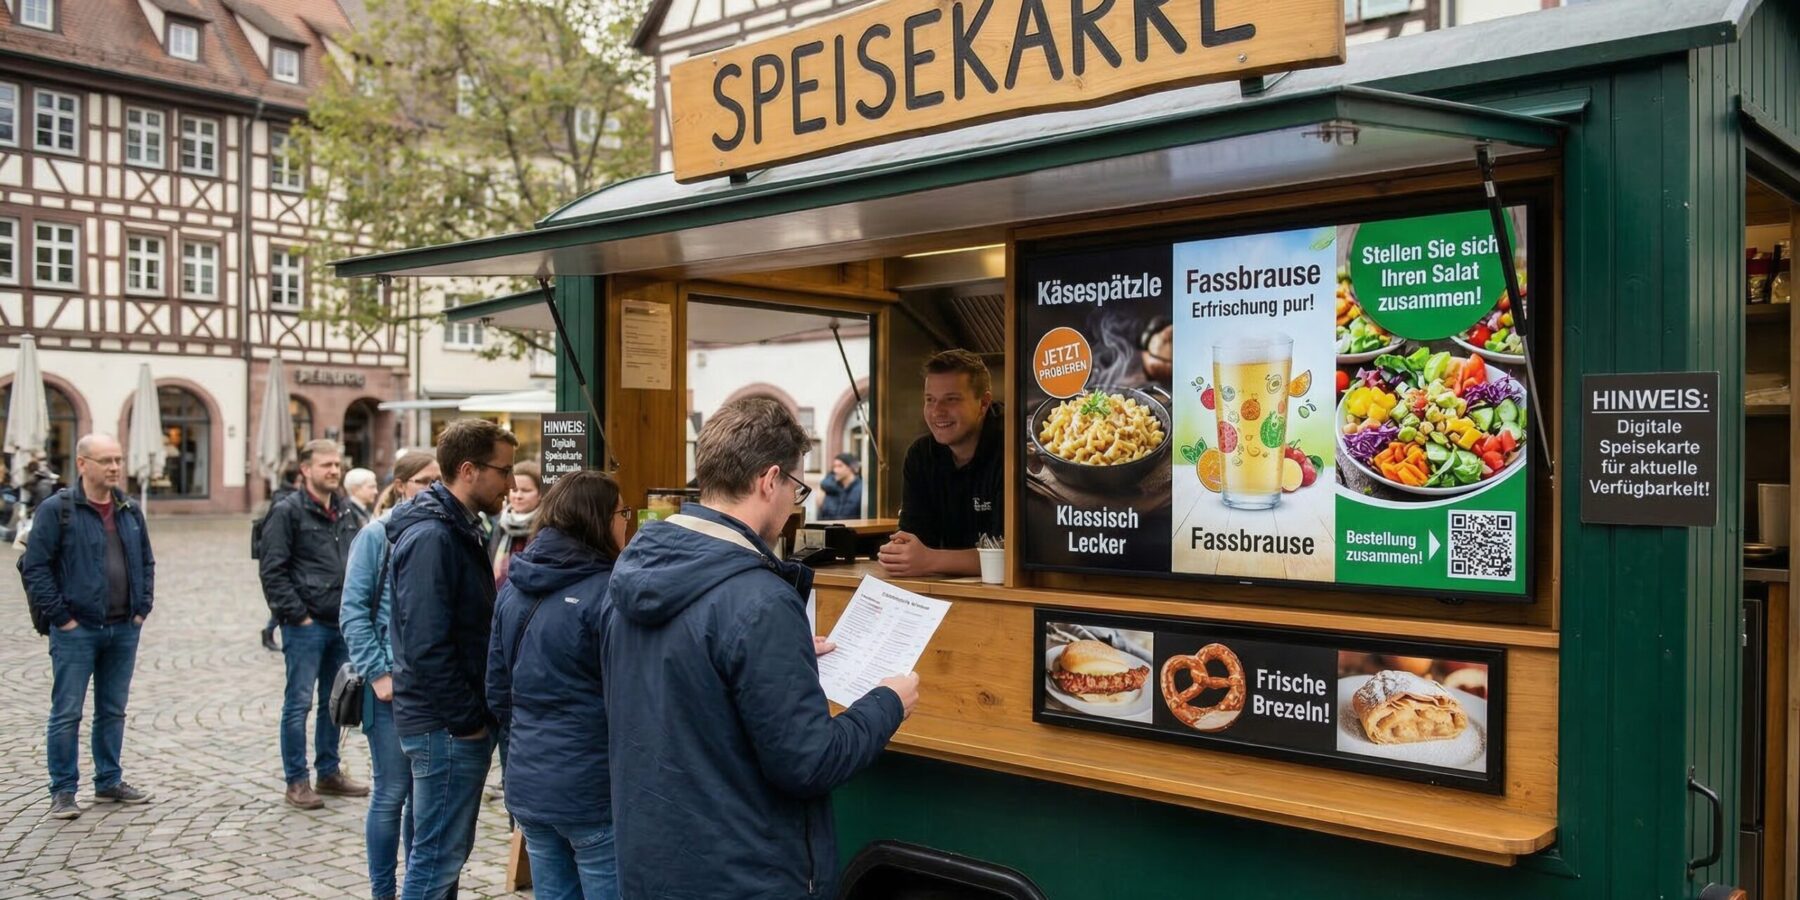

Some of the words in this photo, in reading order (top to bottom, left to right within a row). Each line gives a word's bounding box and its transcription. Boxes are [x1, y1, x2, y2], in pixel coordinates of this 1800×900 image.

[1362, 242, 1422, 265] Stellen
[1427, 238, 1456, 259] Sie
[1461, 234, 1499, 256] sich
[1186, 264, 1321, 294] Fassbrause
[1381, 266, 1427, 287] Ihren
[1432, 262, 1480, 284] Salat
[1037, 272, 1162, 306] Käsespätzle
[1378, 286, 1482, 312] zusammen!
[1192, 298, 1278, 318] Erfrischung
[1283, 294, 1315, 316] pur!
[1042, 342, 1081, 366] JETZT
[1039, 360, 1087, 380] PROBIEREN
[1593, 388, 1708, 410] HINWEIS:
[544, 420, 585, 433] HINWEIS:
[1617, 419, 1682, 437] Digitale
[1600, 440, 1700, 457] Speisekarte
[1601, 459, 1625, 474] für
[1630, 460, 1698, 475] aktuelle
[1056, 504, 1139, 529] Klassisch
[1068, 532, 1126, 555] Lecker
[1191, 526, 1315, 556] Fassbrause
[1346, 530, 1416, 549] Bestellung
[1346, 550, 1423, 565] zusammen!
[1256, 668, 1327, 697] Frische
[1252, 695, 1330, 724] Brezeln!
